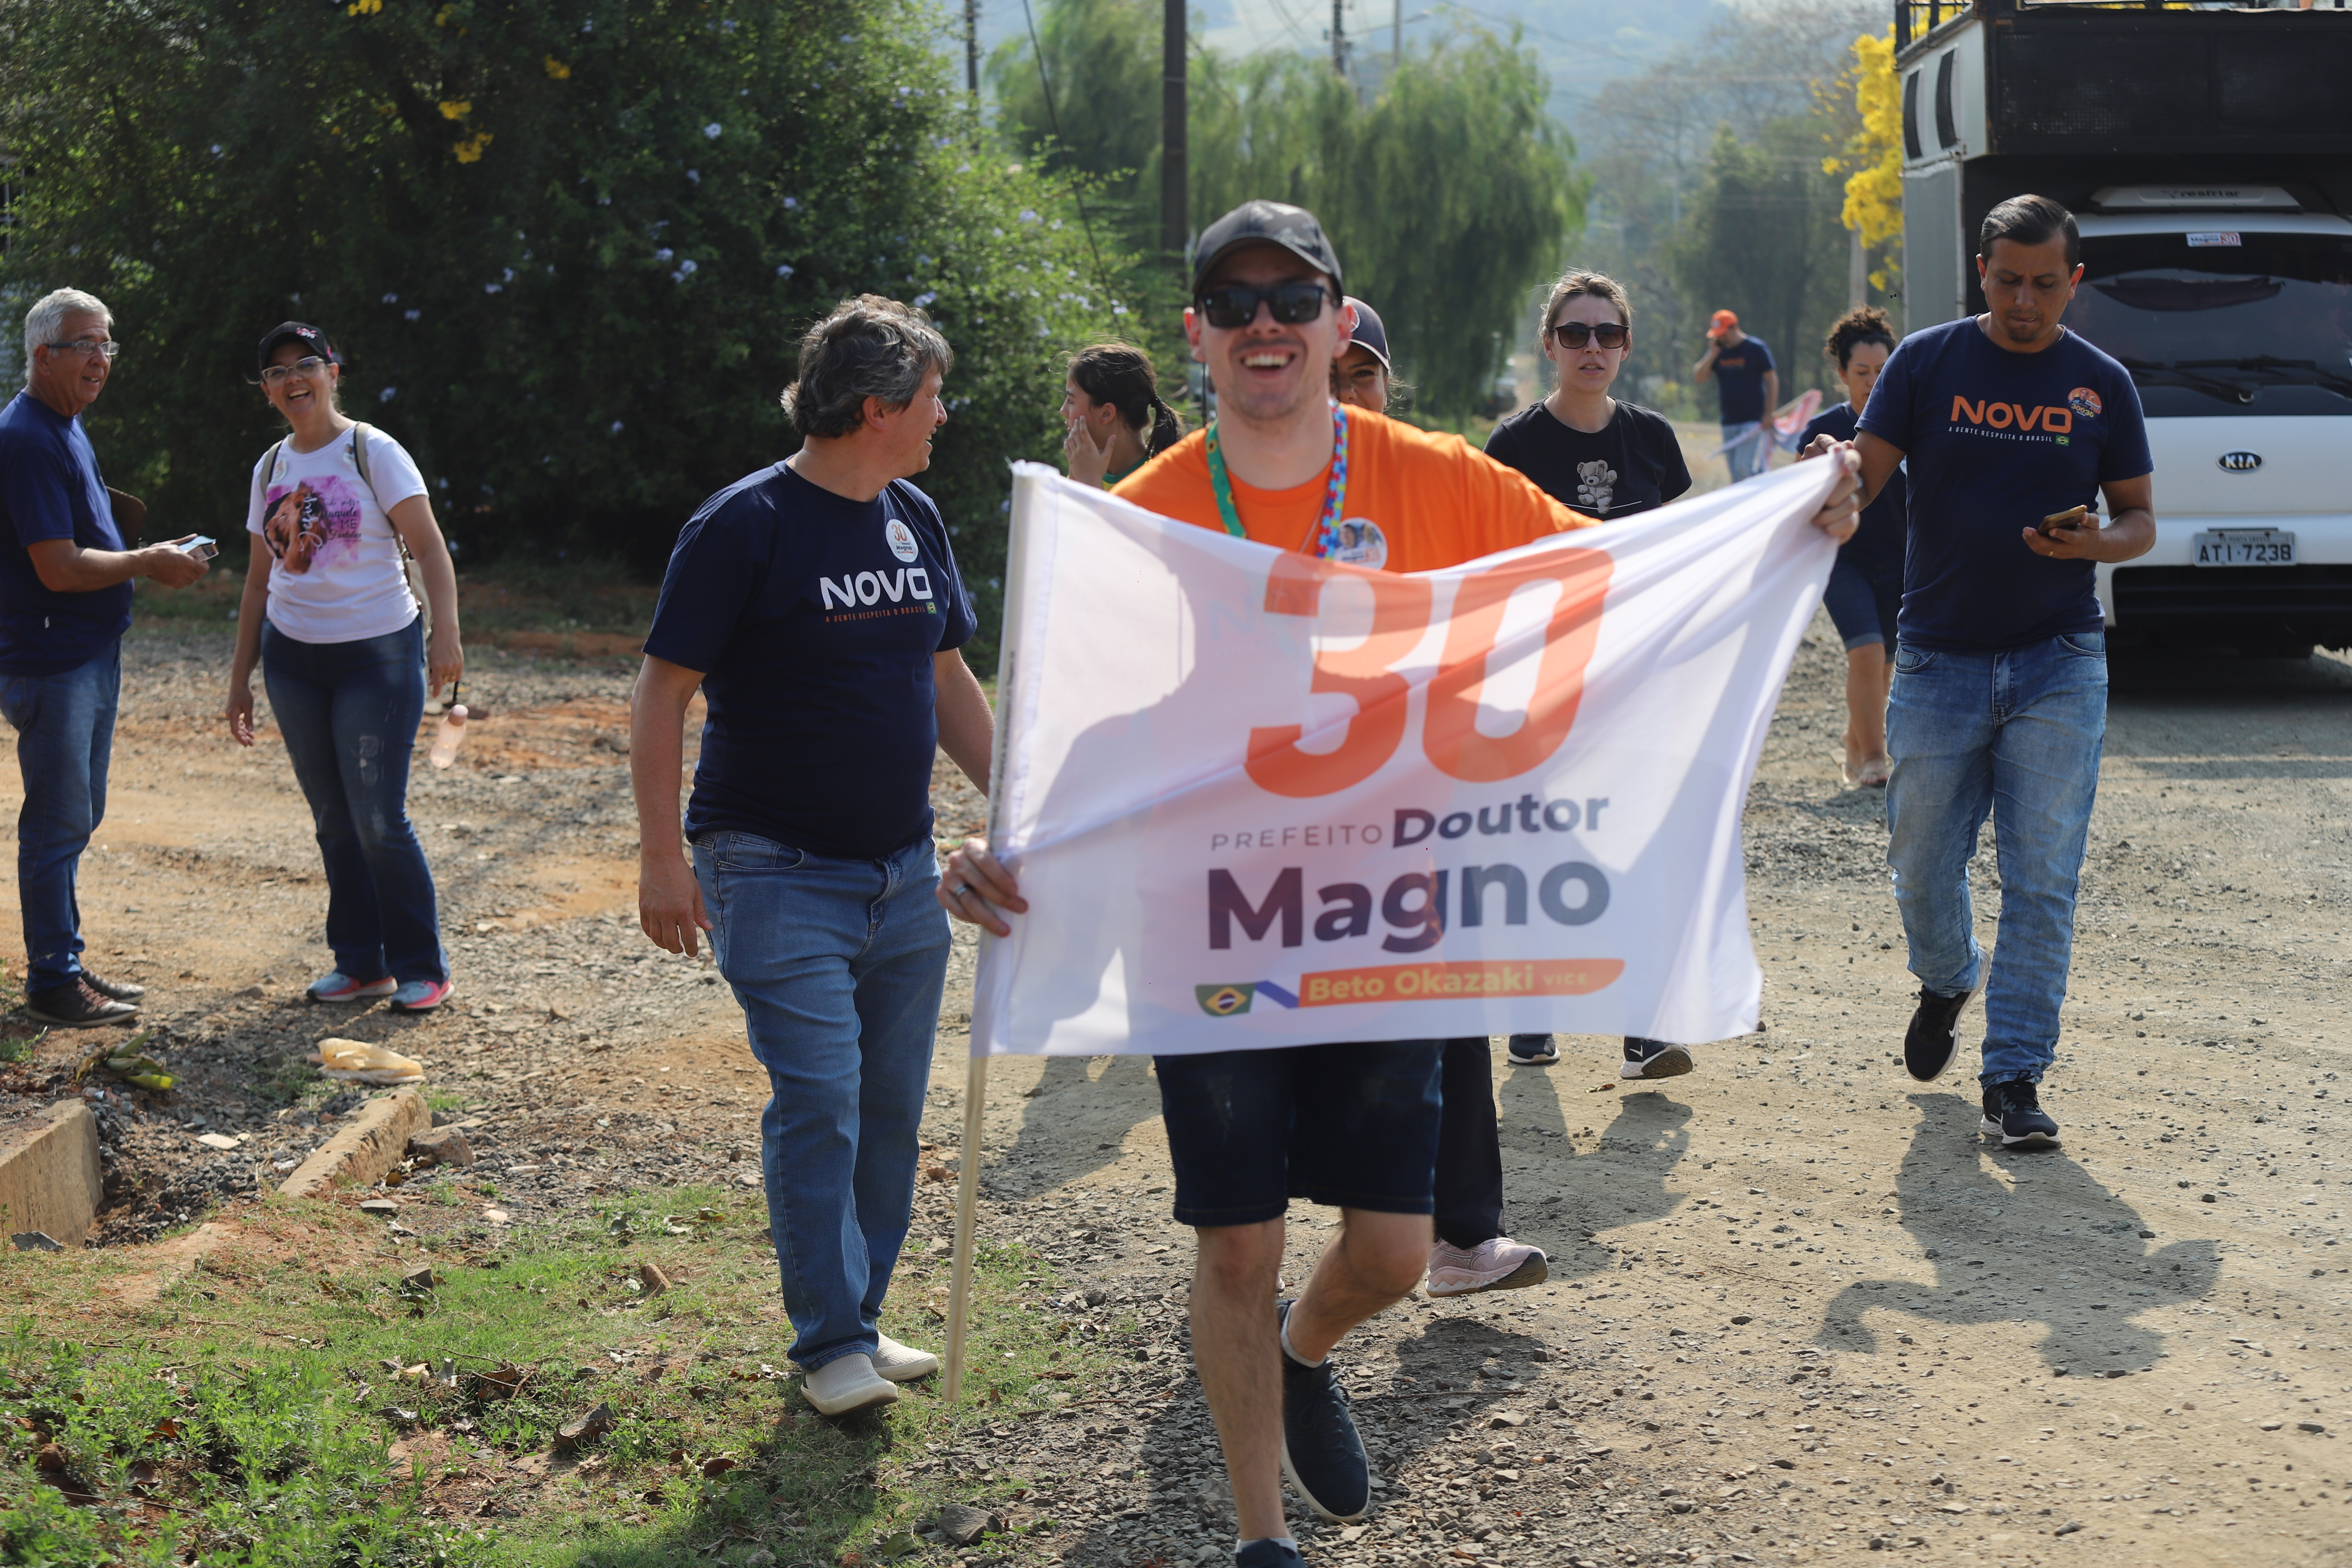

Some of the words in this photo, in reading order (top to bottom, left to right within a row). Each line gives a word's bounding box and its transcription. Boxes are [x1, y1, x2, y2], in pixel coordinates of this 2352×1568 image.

[1951, 395, 2072, 434] NOVO
[2071, 403, 2094, 418] 30030
[1955, 427, 1978, 435] GENTE
[1981, 430, 2015, 440] RESPEITA
[2225, 454, 2256, 469] KIA
[341, 519, 357, 529] ME
[891, 524, 907, 542] 30
[819, 567, 933, 610] NOVO
[834, 613, 856, 622] GENTE
[858, 609, 891, 620] RESPEITA
[900, 606, 926, 614] BRASIL
[1243, 548, 1614, 798] 30
[1211, 824, 1383, 851] PREFEITO
[1392, 793, 1610, 849] Doutor
[1208, 861, 1611, 954] Magno
[1308, 975, 1385, 1001] Beto
[1395, 964, 1534, 995] Okazaki
[1543, 972, 1588, 986] VICE
